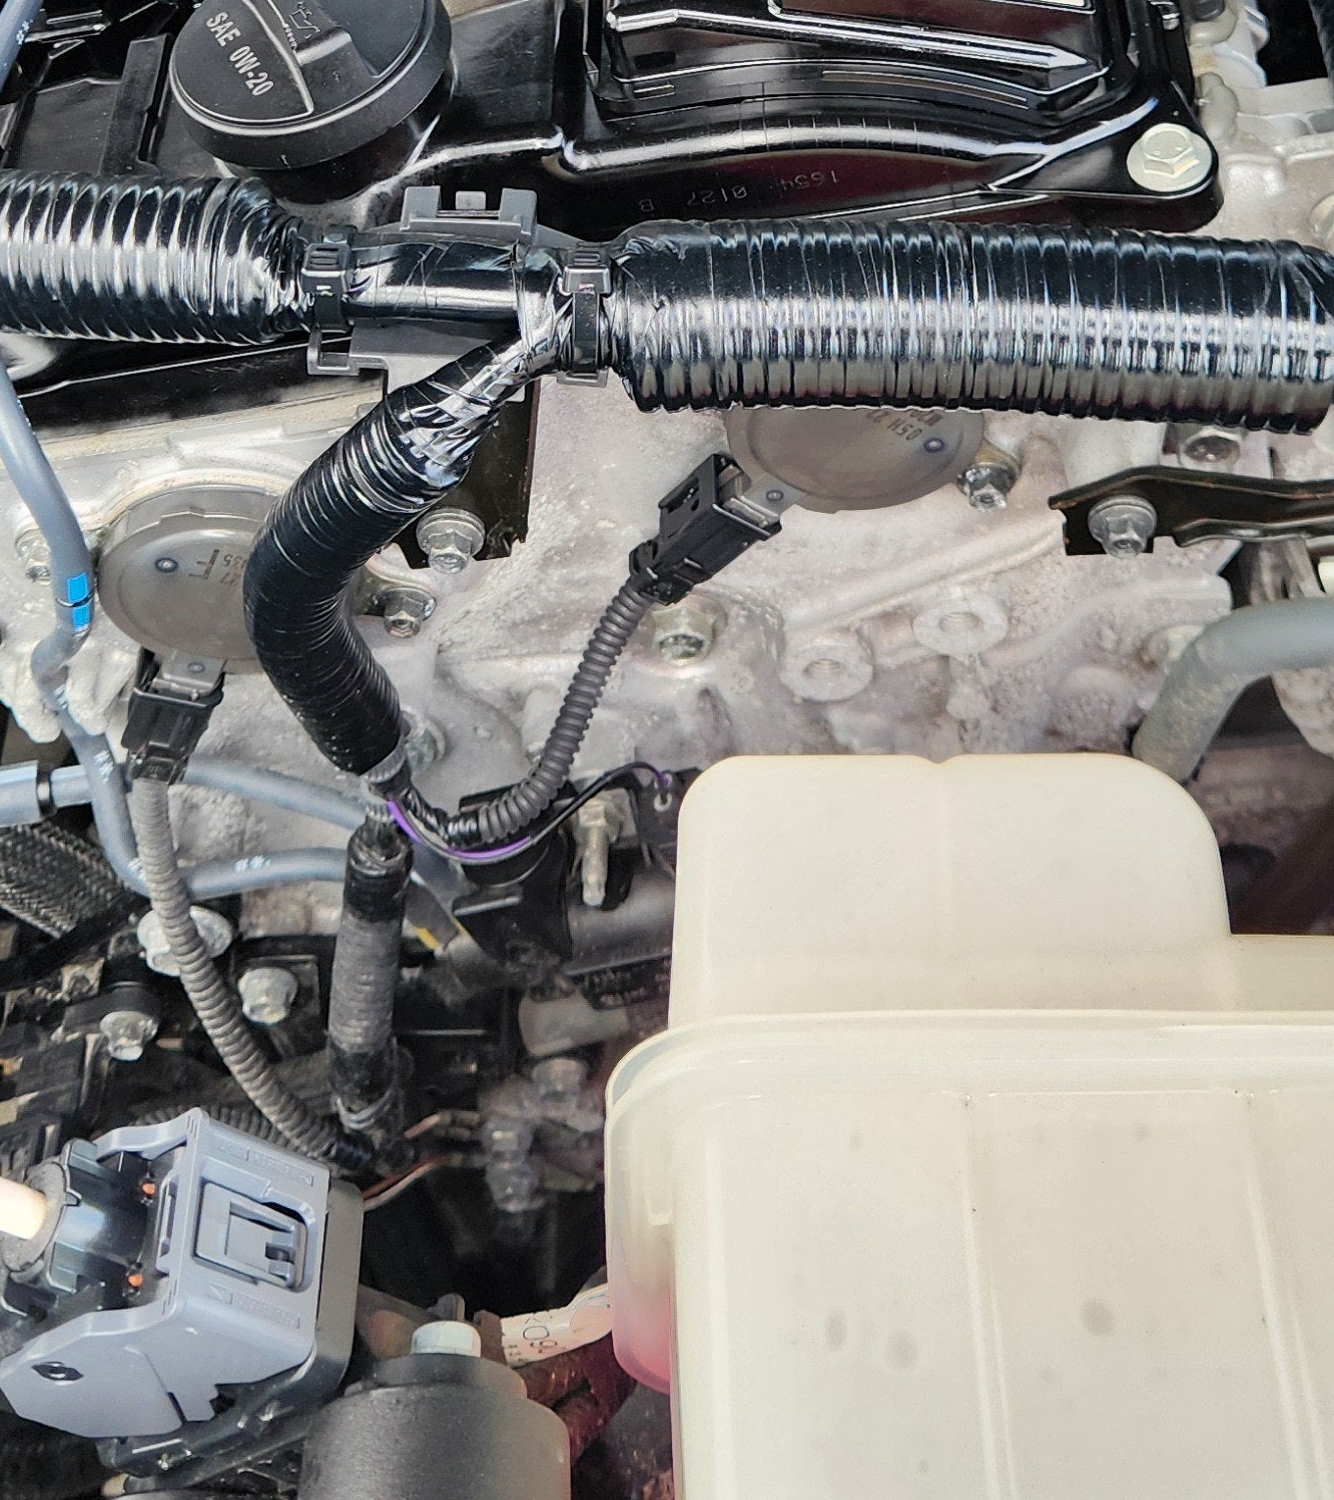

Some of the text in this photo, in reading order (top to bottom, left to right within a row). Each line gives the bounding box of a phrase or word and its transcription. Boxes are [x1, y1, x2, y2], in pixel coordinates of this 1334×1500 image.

[206, 12, 274, 96] SAE 0W-20
[188, 549, 220, 580] F
